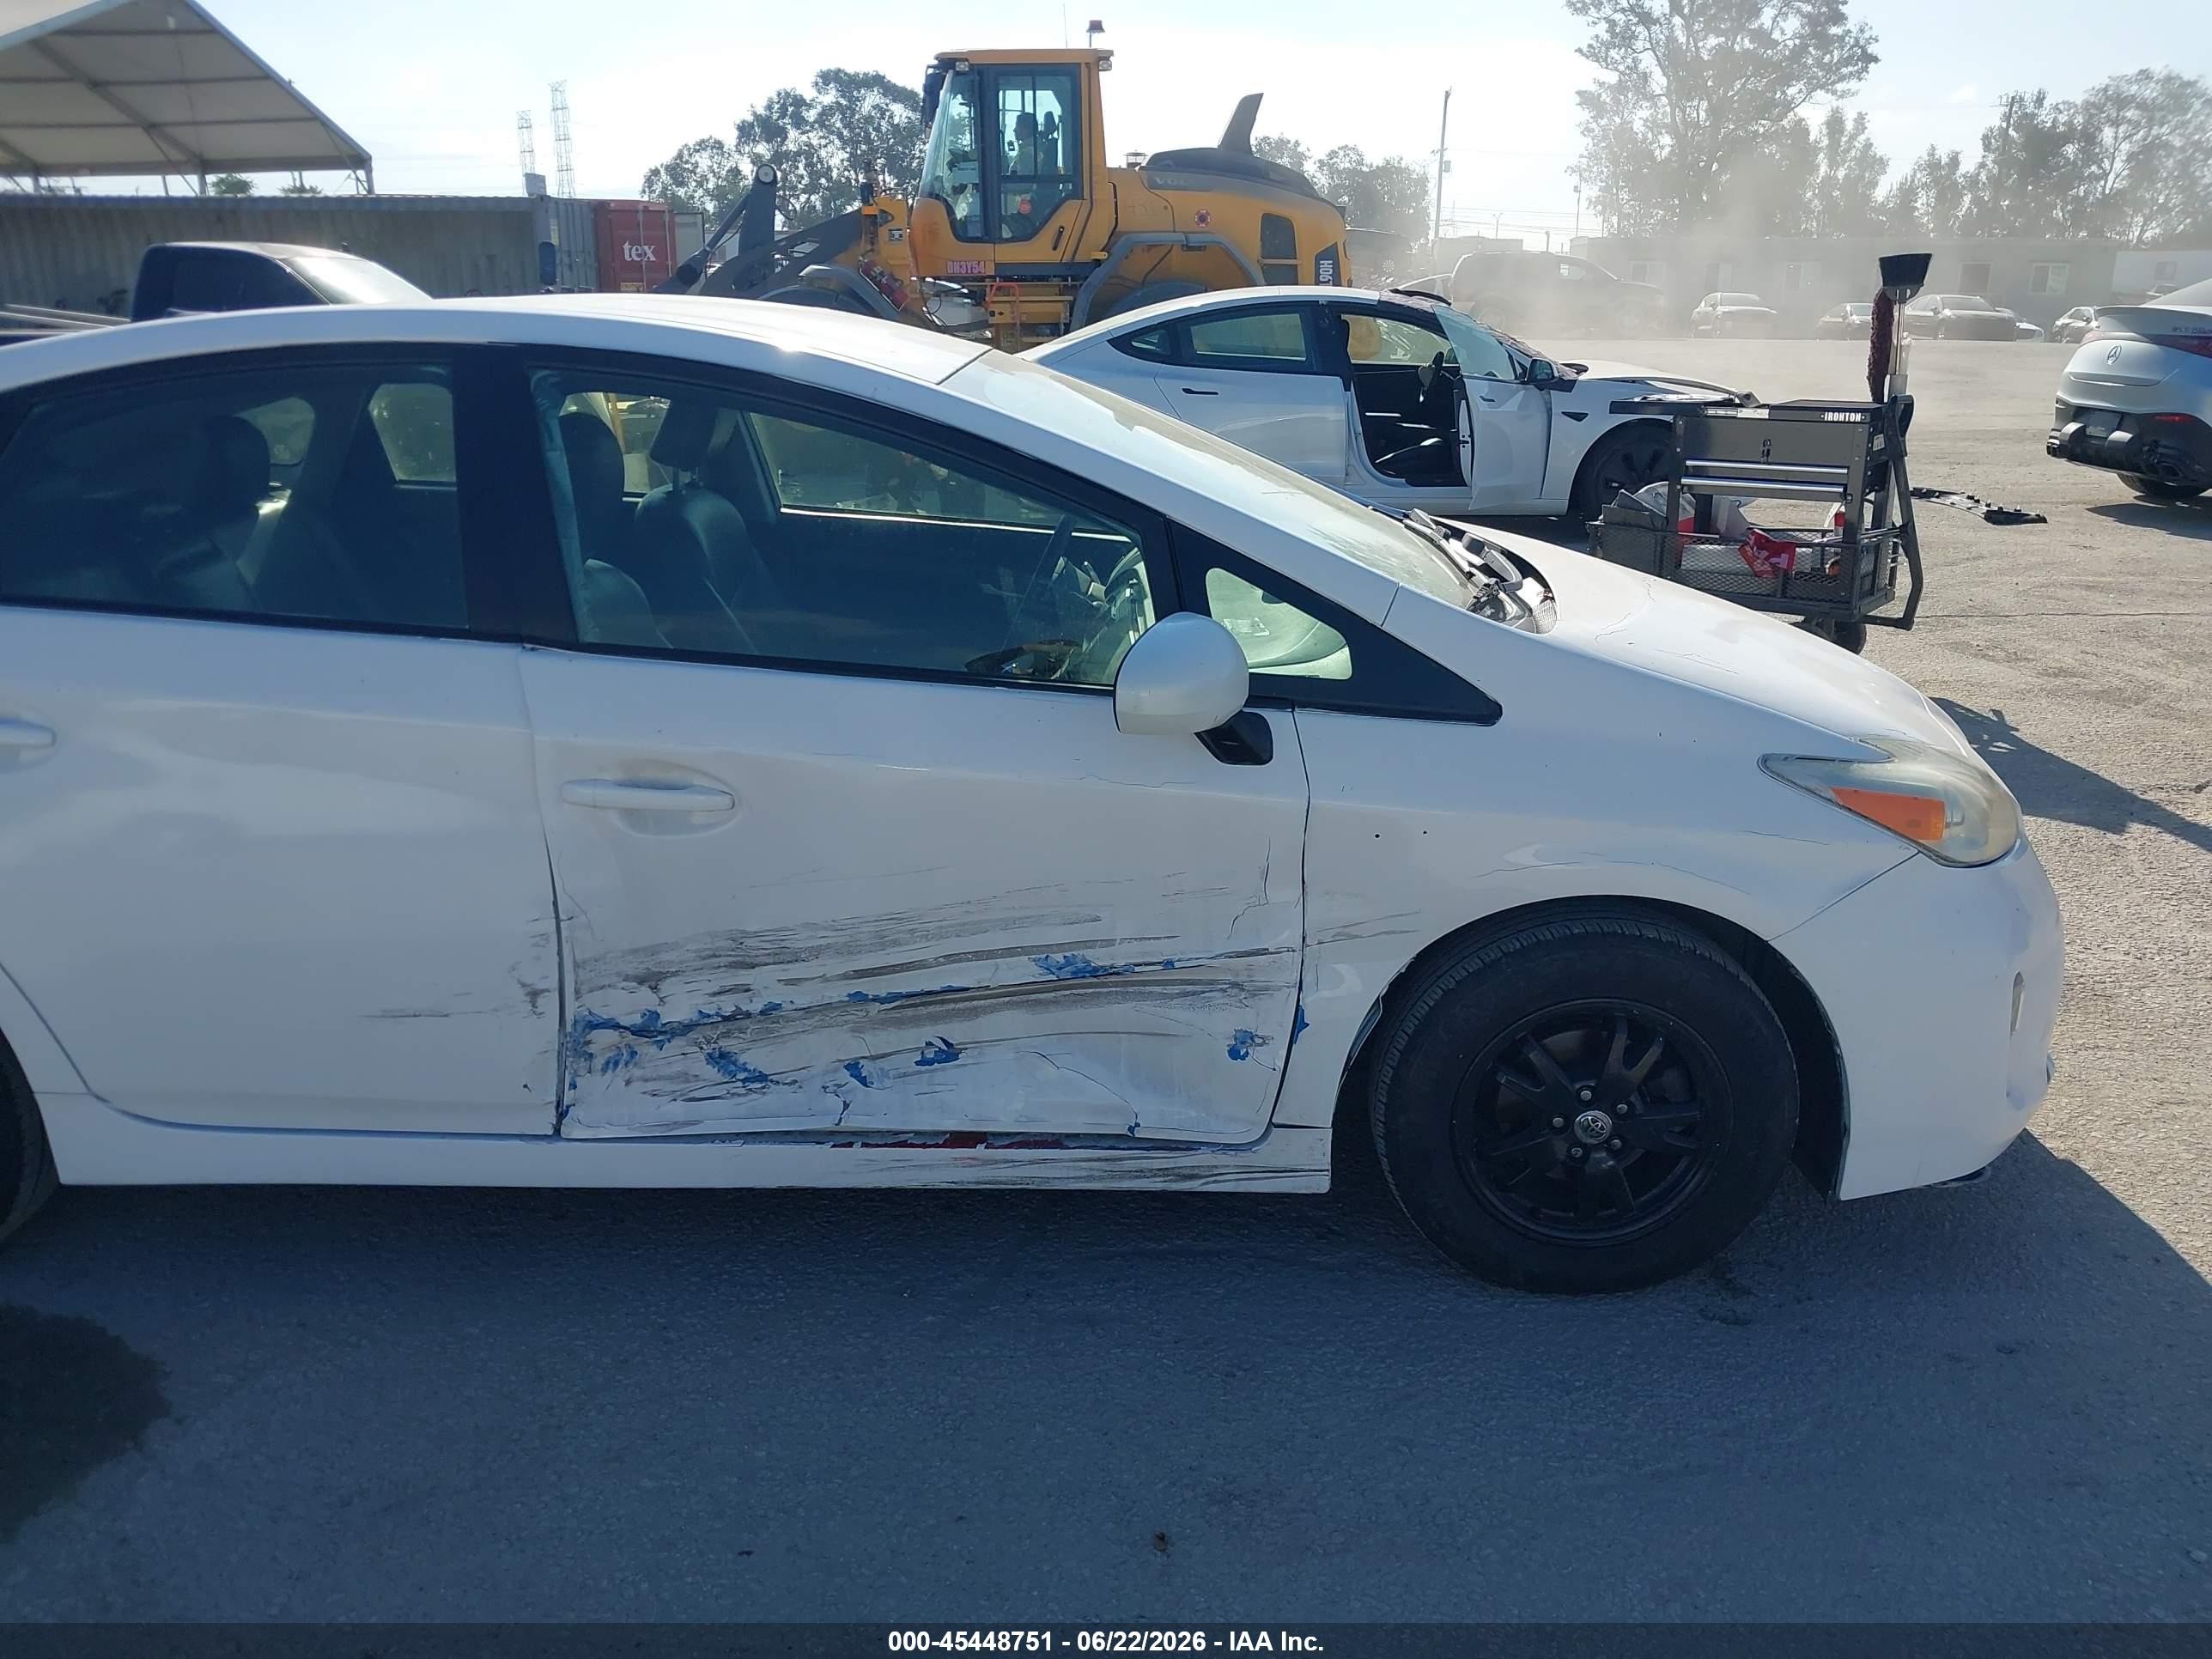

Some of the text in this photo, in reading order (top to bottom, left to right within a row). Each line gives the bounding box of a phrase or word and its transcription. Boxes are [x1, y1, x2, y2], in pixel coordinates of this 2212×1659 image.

[623, 240, 657, 261] tex
[1319, 260, 1334, 286] L90H
[1824, 411, 1862, 422] IRONTON
